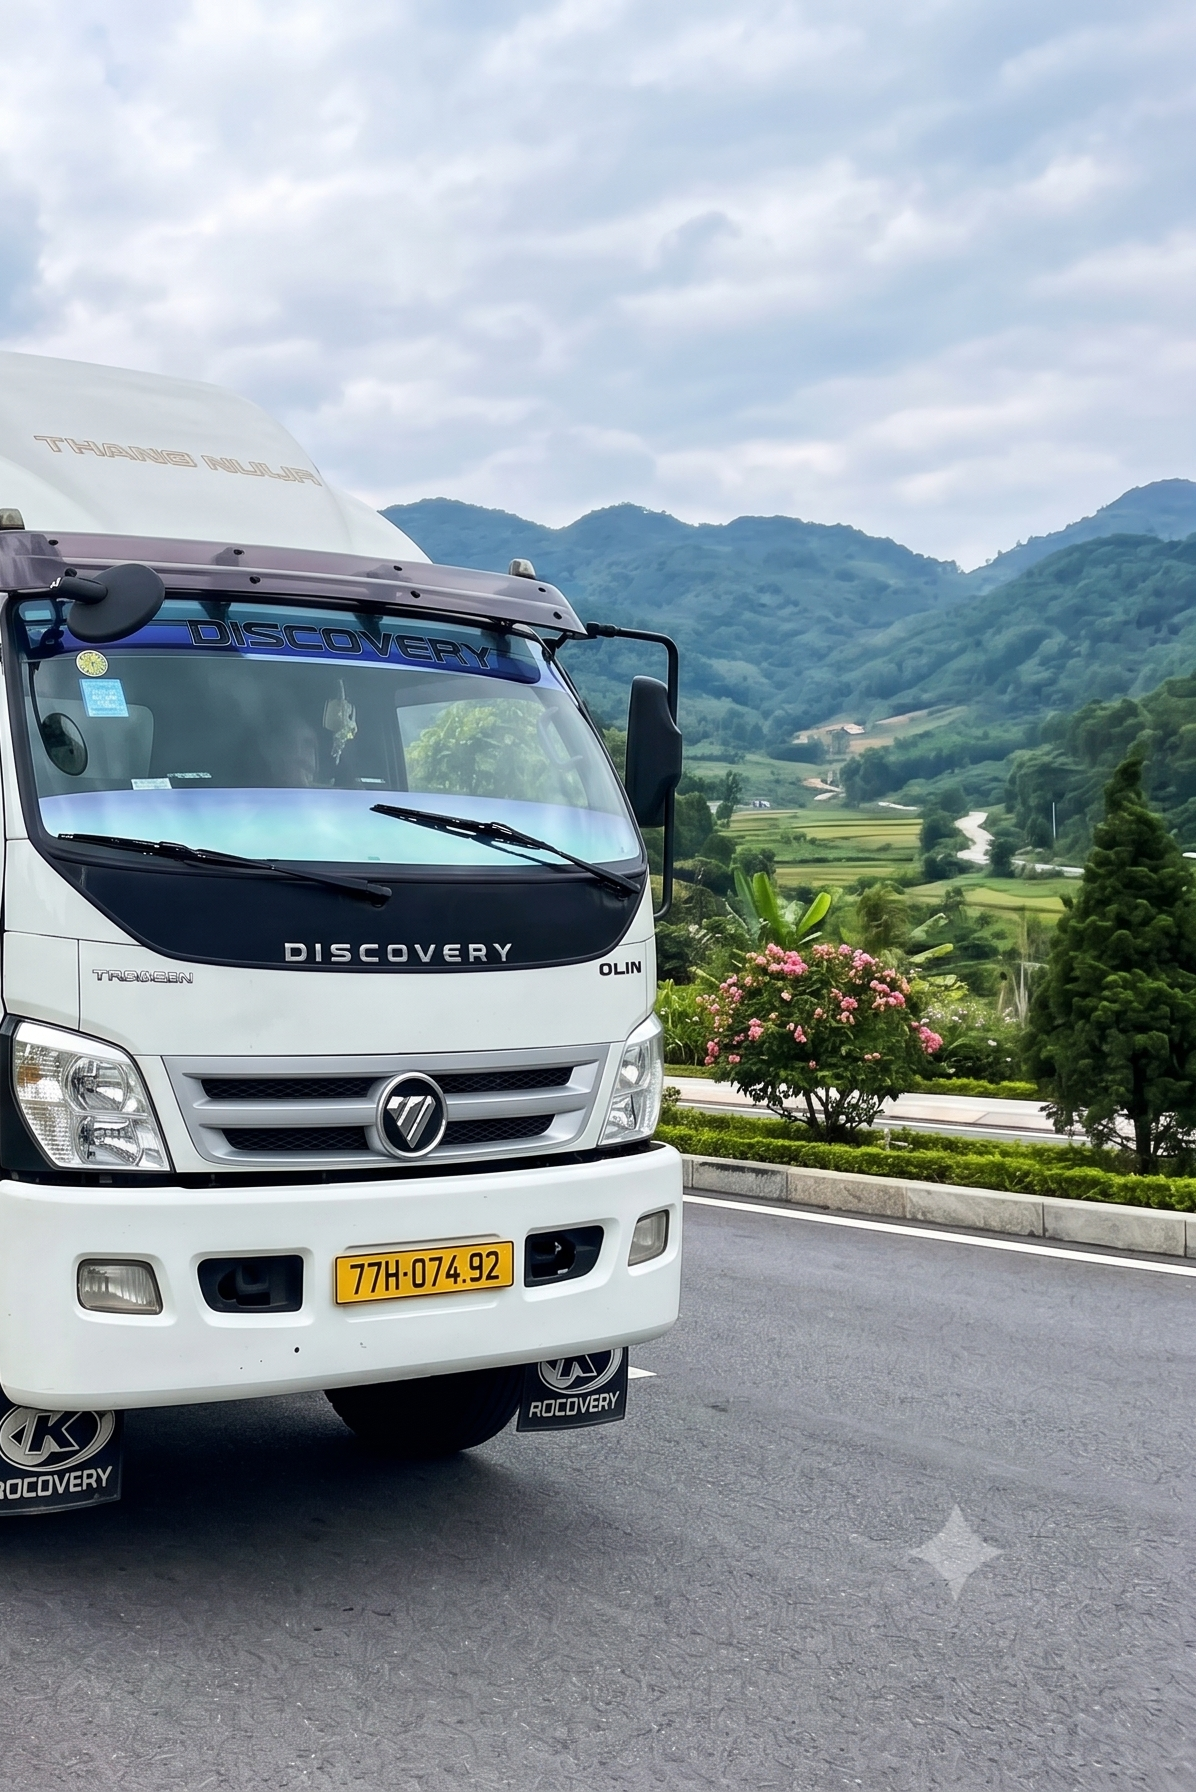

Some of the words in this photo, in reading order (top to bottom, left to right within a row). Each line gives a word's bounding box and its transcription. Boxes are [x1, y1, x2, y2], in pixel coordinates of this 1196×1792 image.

[186, 618, 491, 669] DISCOVERY
[284, 942, 513, 963] DISCOVERY
[599, 960, 642, 976] OLIN
[529, 1391, 620, 1418] ROCOVERY
